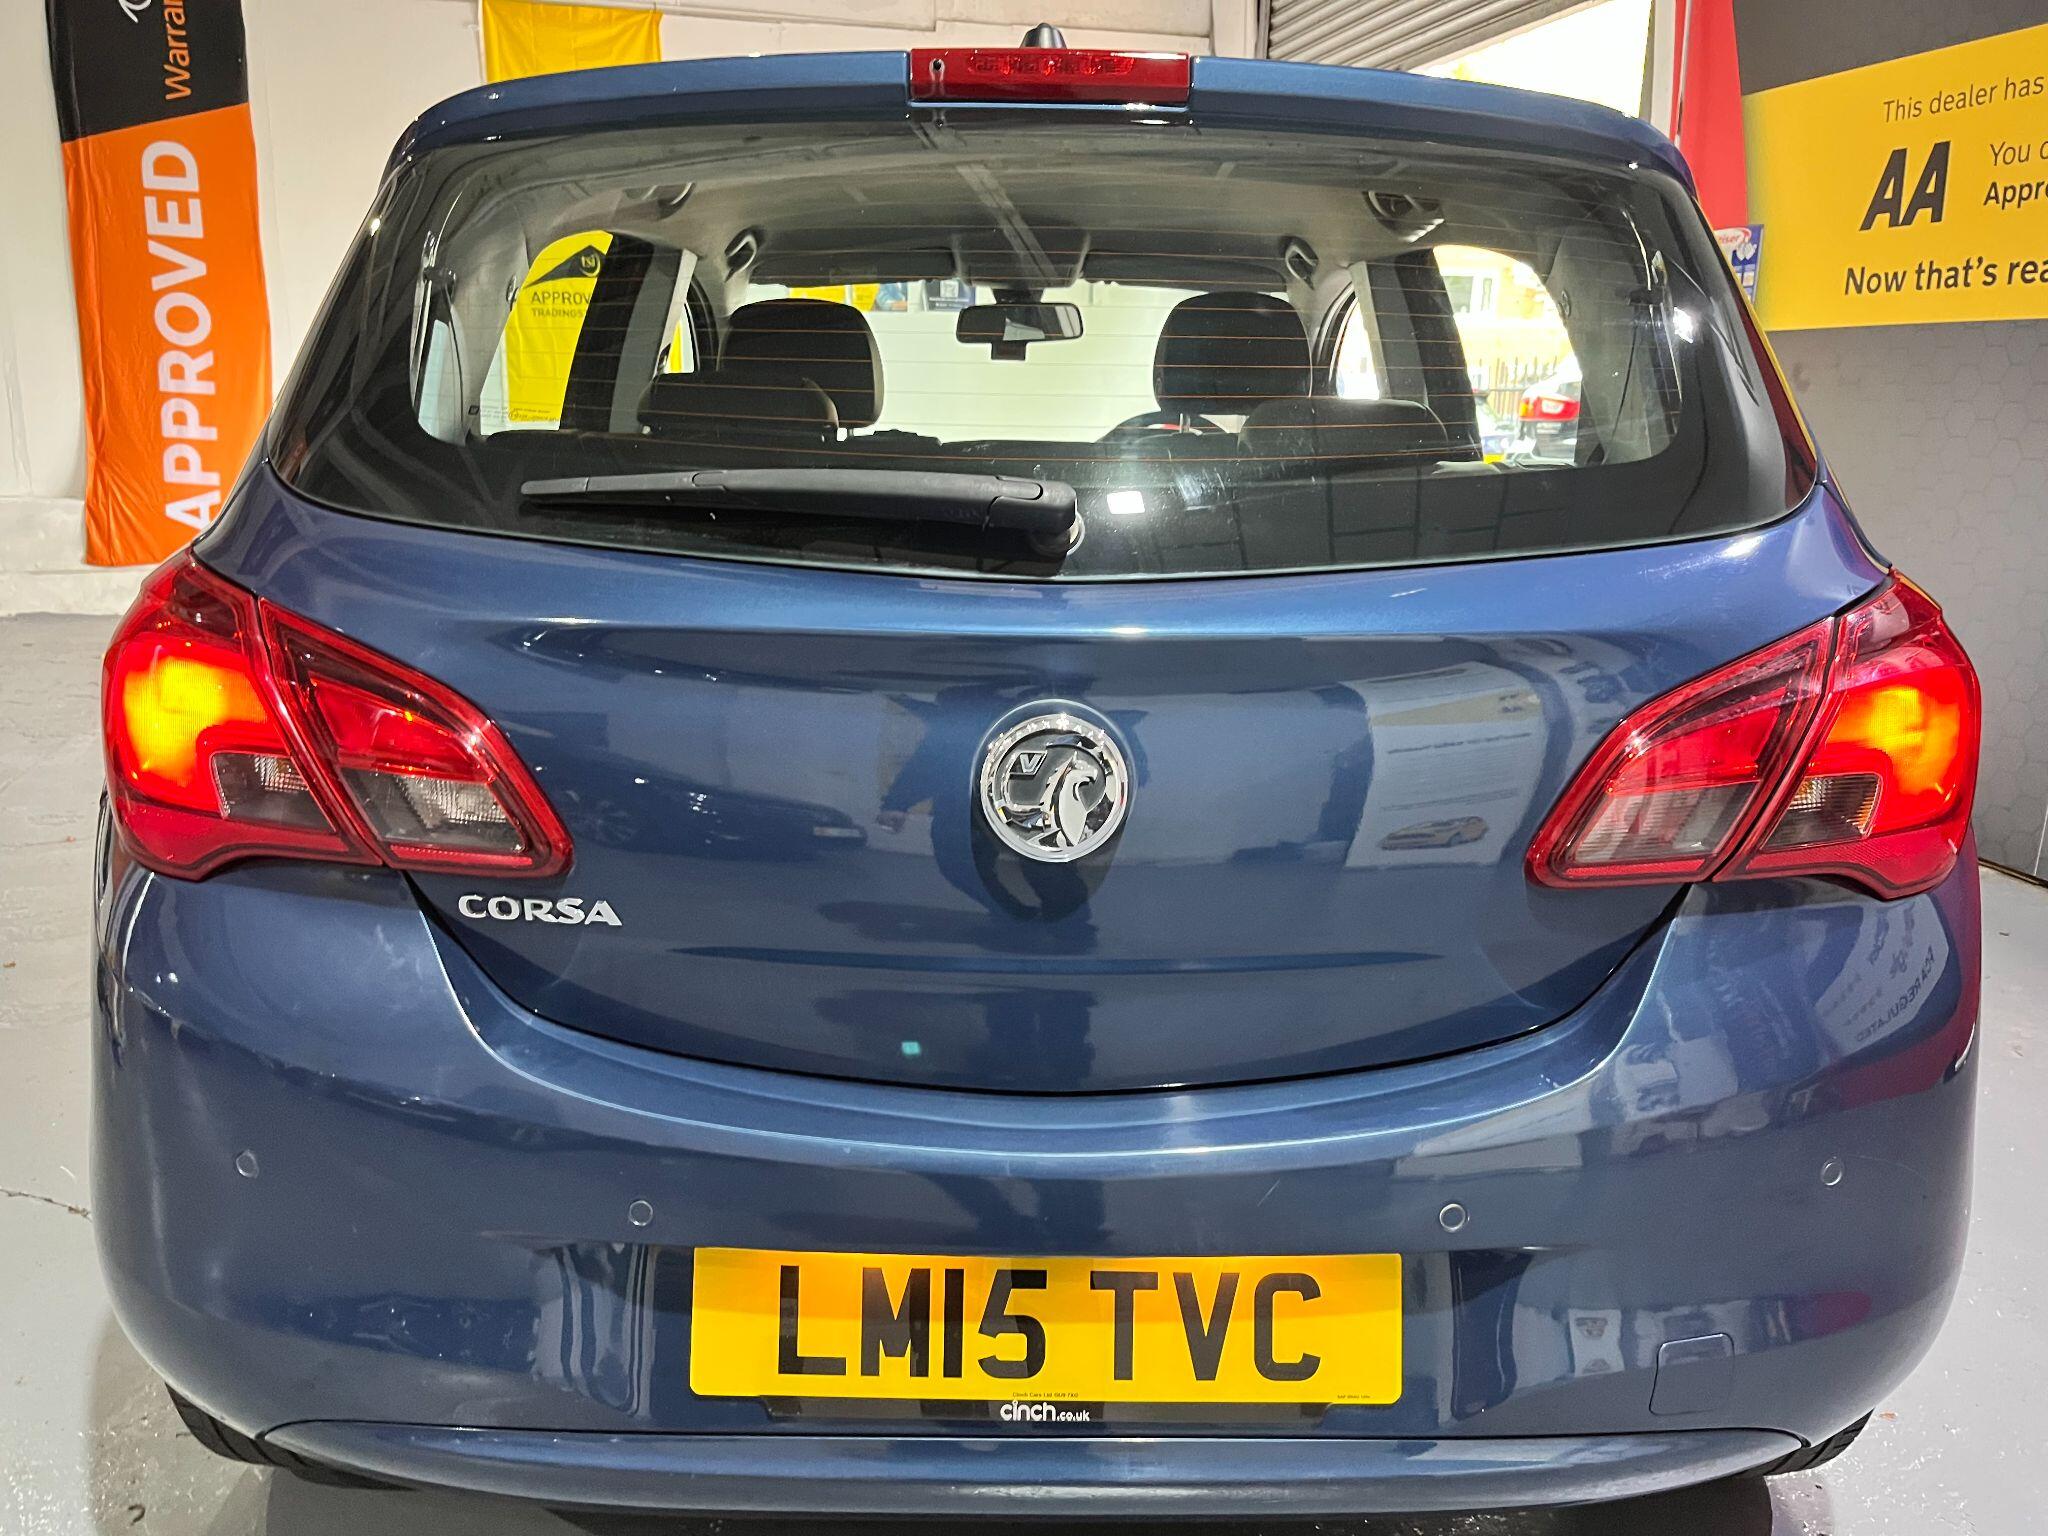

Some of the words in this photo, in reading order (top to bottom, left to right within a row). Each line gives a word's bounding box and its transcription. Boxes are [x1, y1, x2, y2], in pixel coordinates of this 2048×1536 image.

[1883, 97, 1922, 122] This
[1929, 83, 1998, 115] dealer
[2003, 76, 2045, 100] has
[1990, 141, 2031, 166] You
[1858, 140, 1951, 231] AA
[1983, 180, 2048, 210] Appr
[1844, 266, 1907, 295] Now
[141, 140, 222, 532] APPROVED
[458, 894, 623, 926] CORSA
[778, 1265, 1047, 1379] LM15
[1090, 1269, 1322, 1382] TVC
